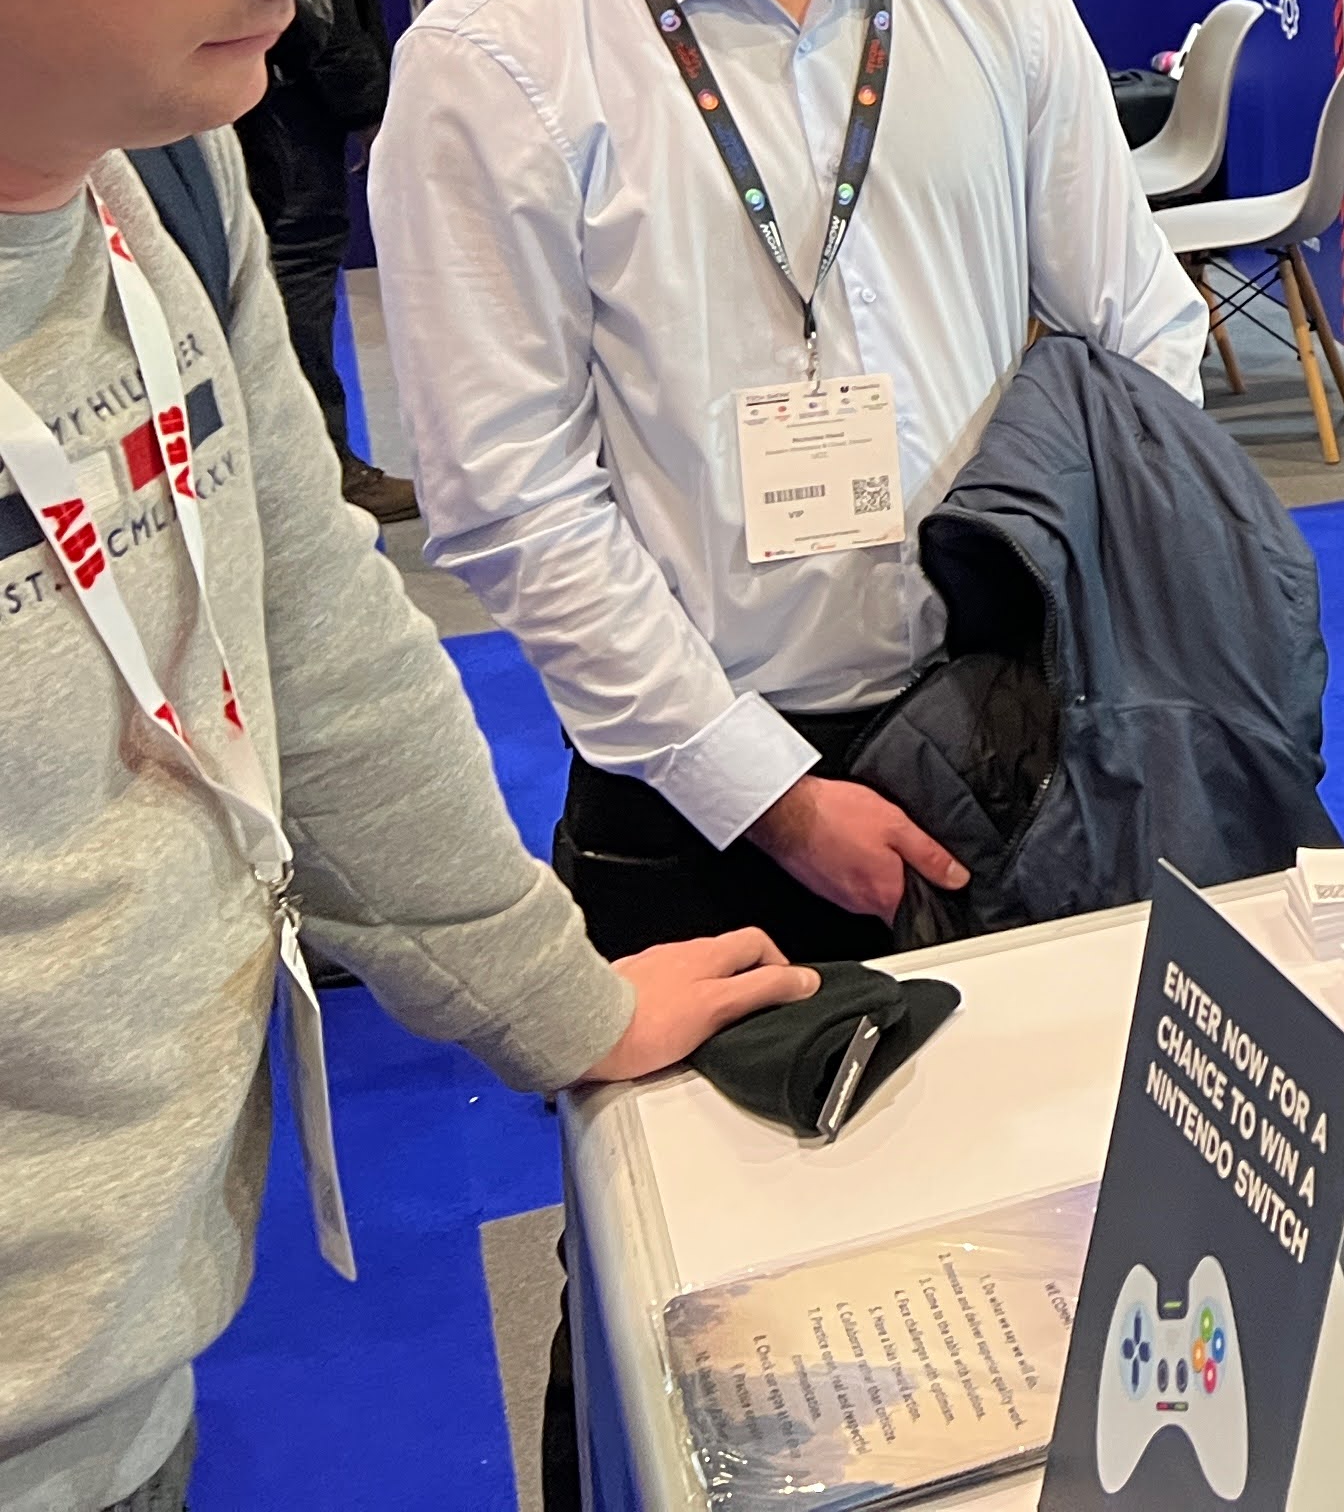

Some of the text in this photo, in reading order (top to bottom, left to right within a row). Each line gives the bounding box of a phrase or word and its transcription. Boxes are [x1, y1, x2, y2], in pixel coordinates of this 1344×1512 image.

[40, 498, 105, 589] ABB
[1157, 1015, 1316, 1208] CHANCE TO WIN A
[1164, 961, 1327, 1154] ENTER NOW FOR A
[1145, 1062, 1309, 1264] NINTENDO SWITCH
